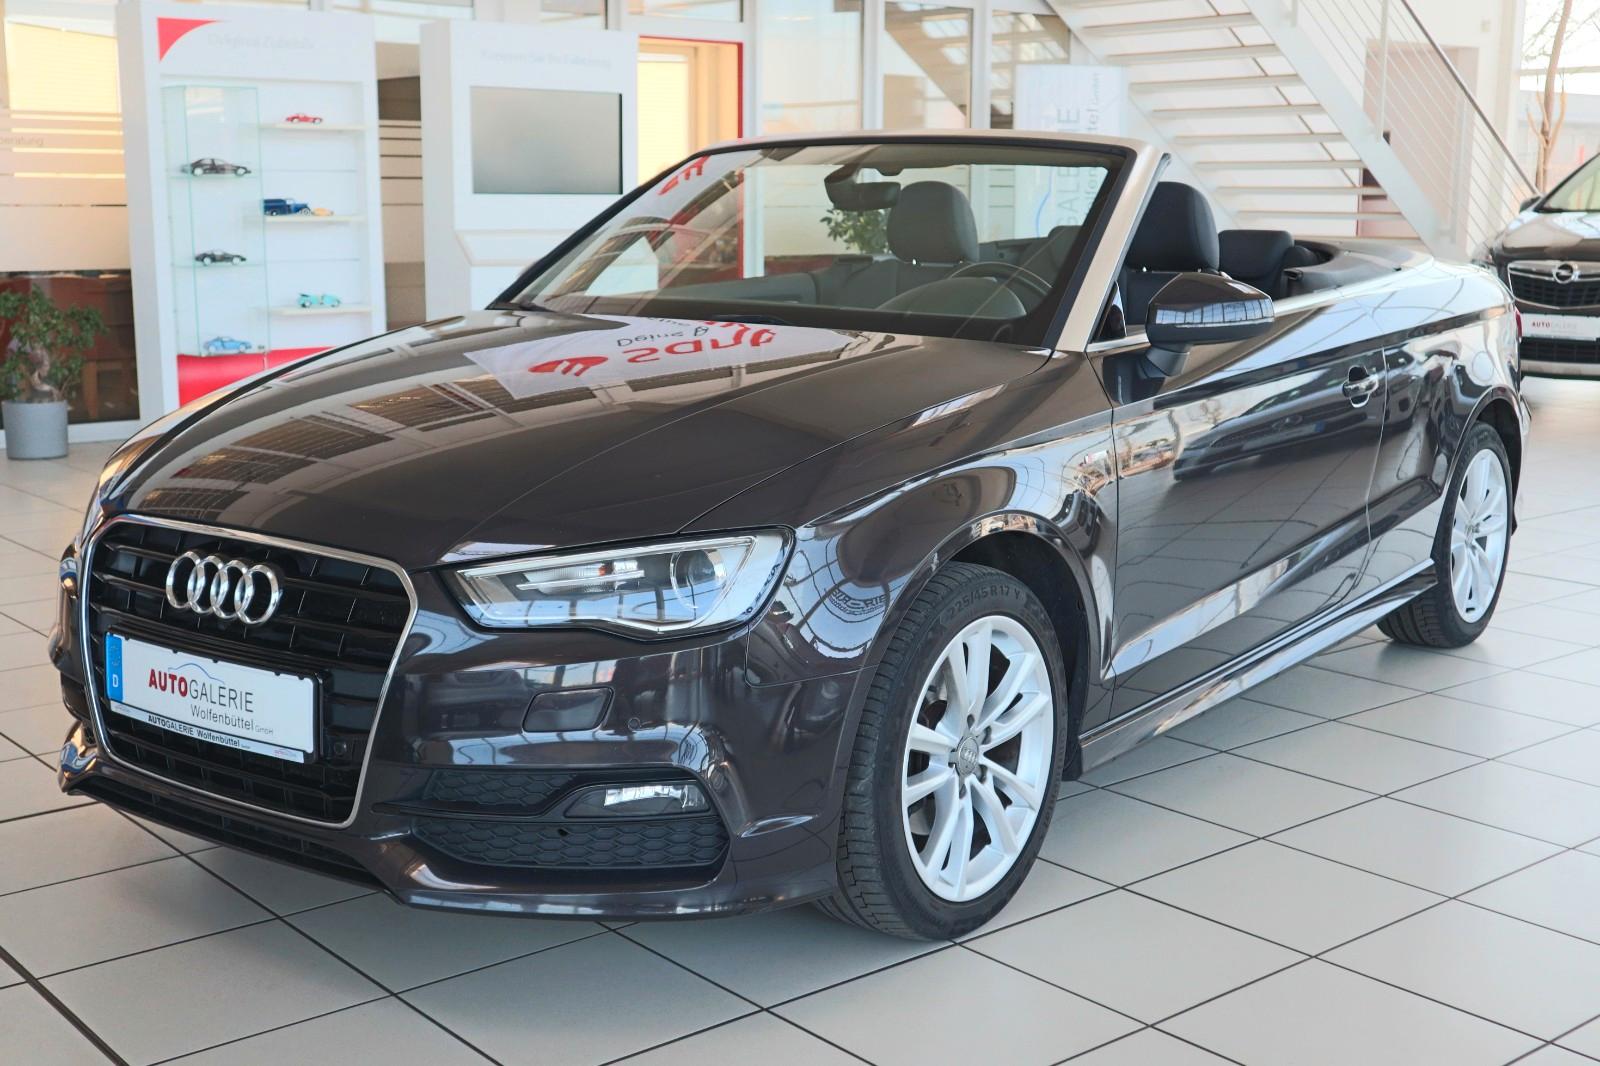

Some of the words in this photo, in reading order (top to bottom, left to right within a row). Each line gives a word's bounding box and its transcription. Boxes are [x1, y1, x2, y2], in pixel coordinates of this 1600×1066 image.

[112, 674, 119, 688] D
[191, 703, 254, 731] Wolfenbüttel
[197, 728, 240, 748] Wolfenbüttel
